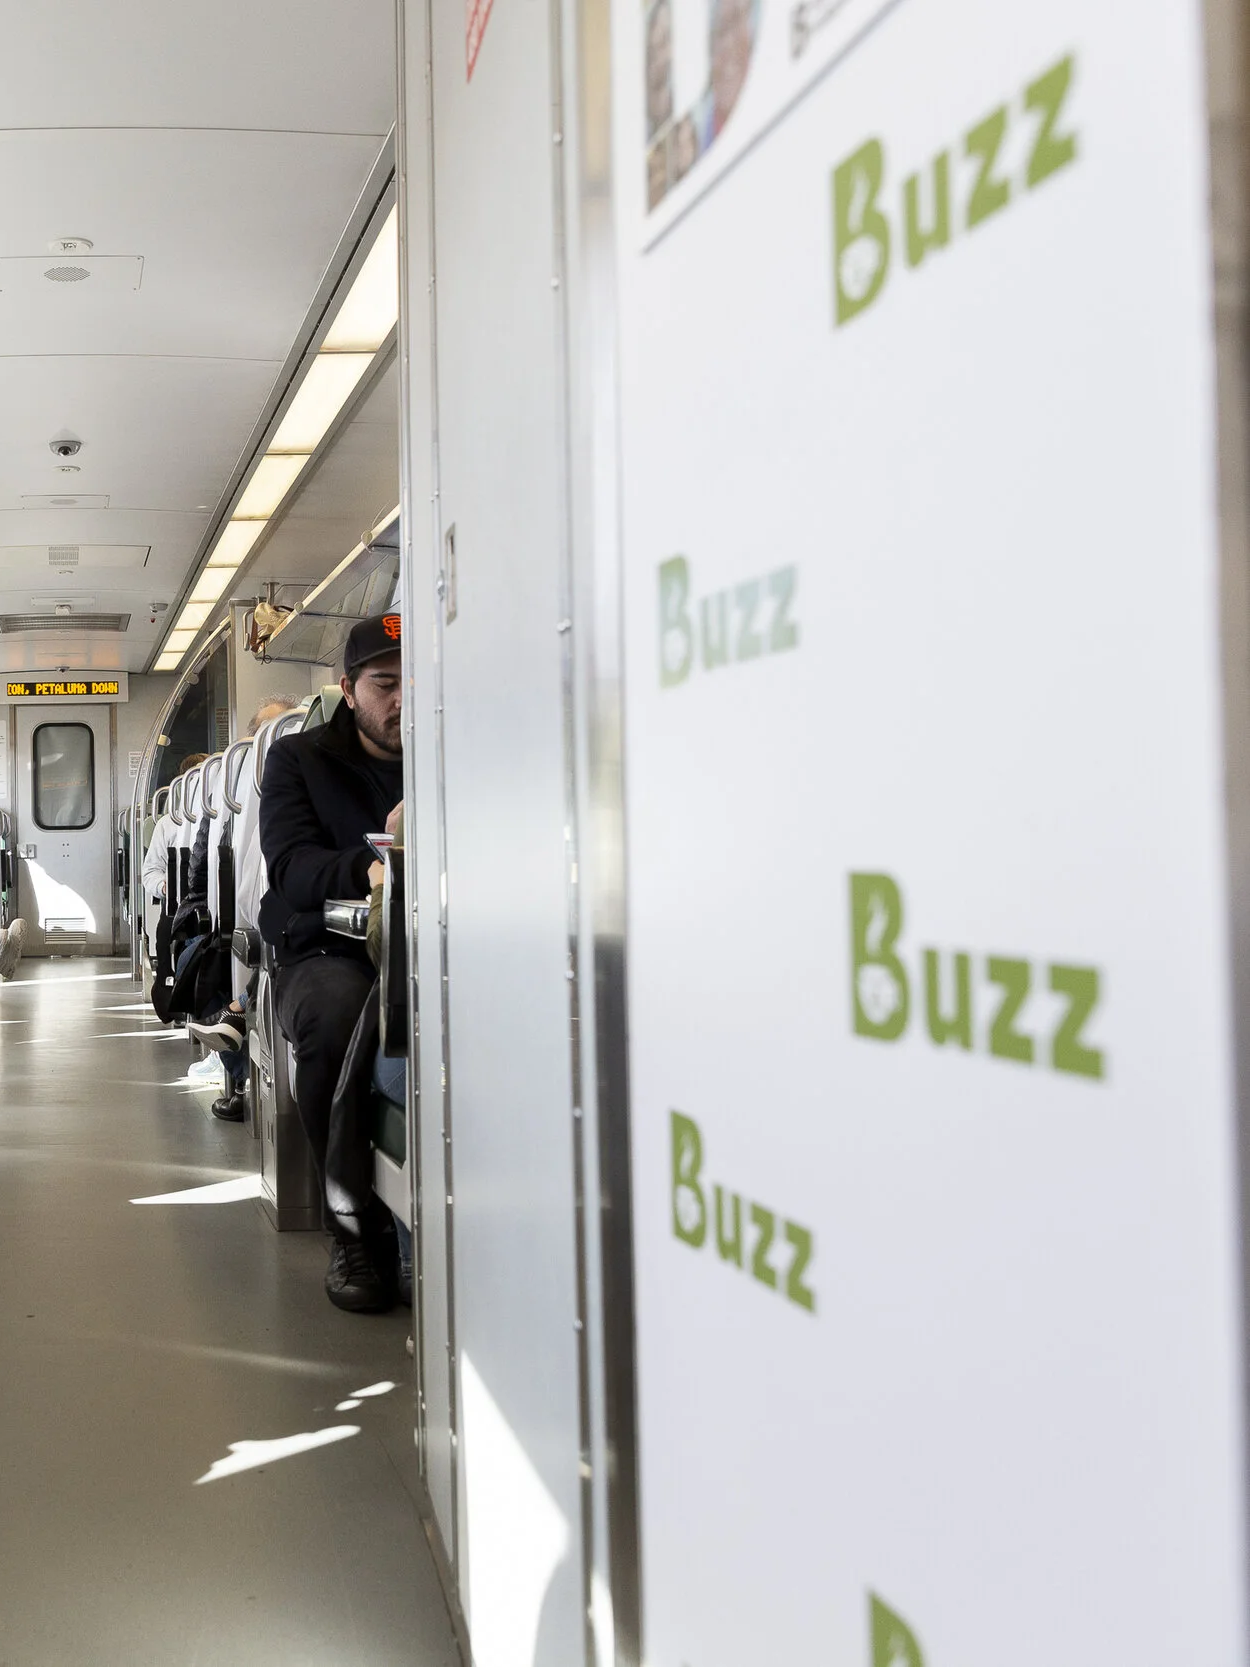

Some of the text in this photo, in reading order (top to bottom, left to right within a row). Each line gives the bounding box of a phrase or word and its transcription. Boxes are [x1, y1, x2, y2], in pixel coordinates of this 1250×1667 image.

[832, 54, 1076, 326] Buzz
[36, 683, 87, 695] PETALUMA
[91, 682, 119, 694] DOWN
[659, 554, 796, 688] Buzz
[849, 872, 1104, 1079] Buzz
[670, 1112, 815, 1313] Buzz
